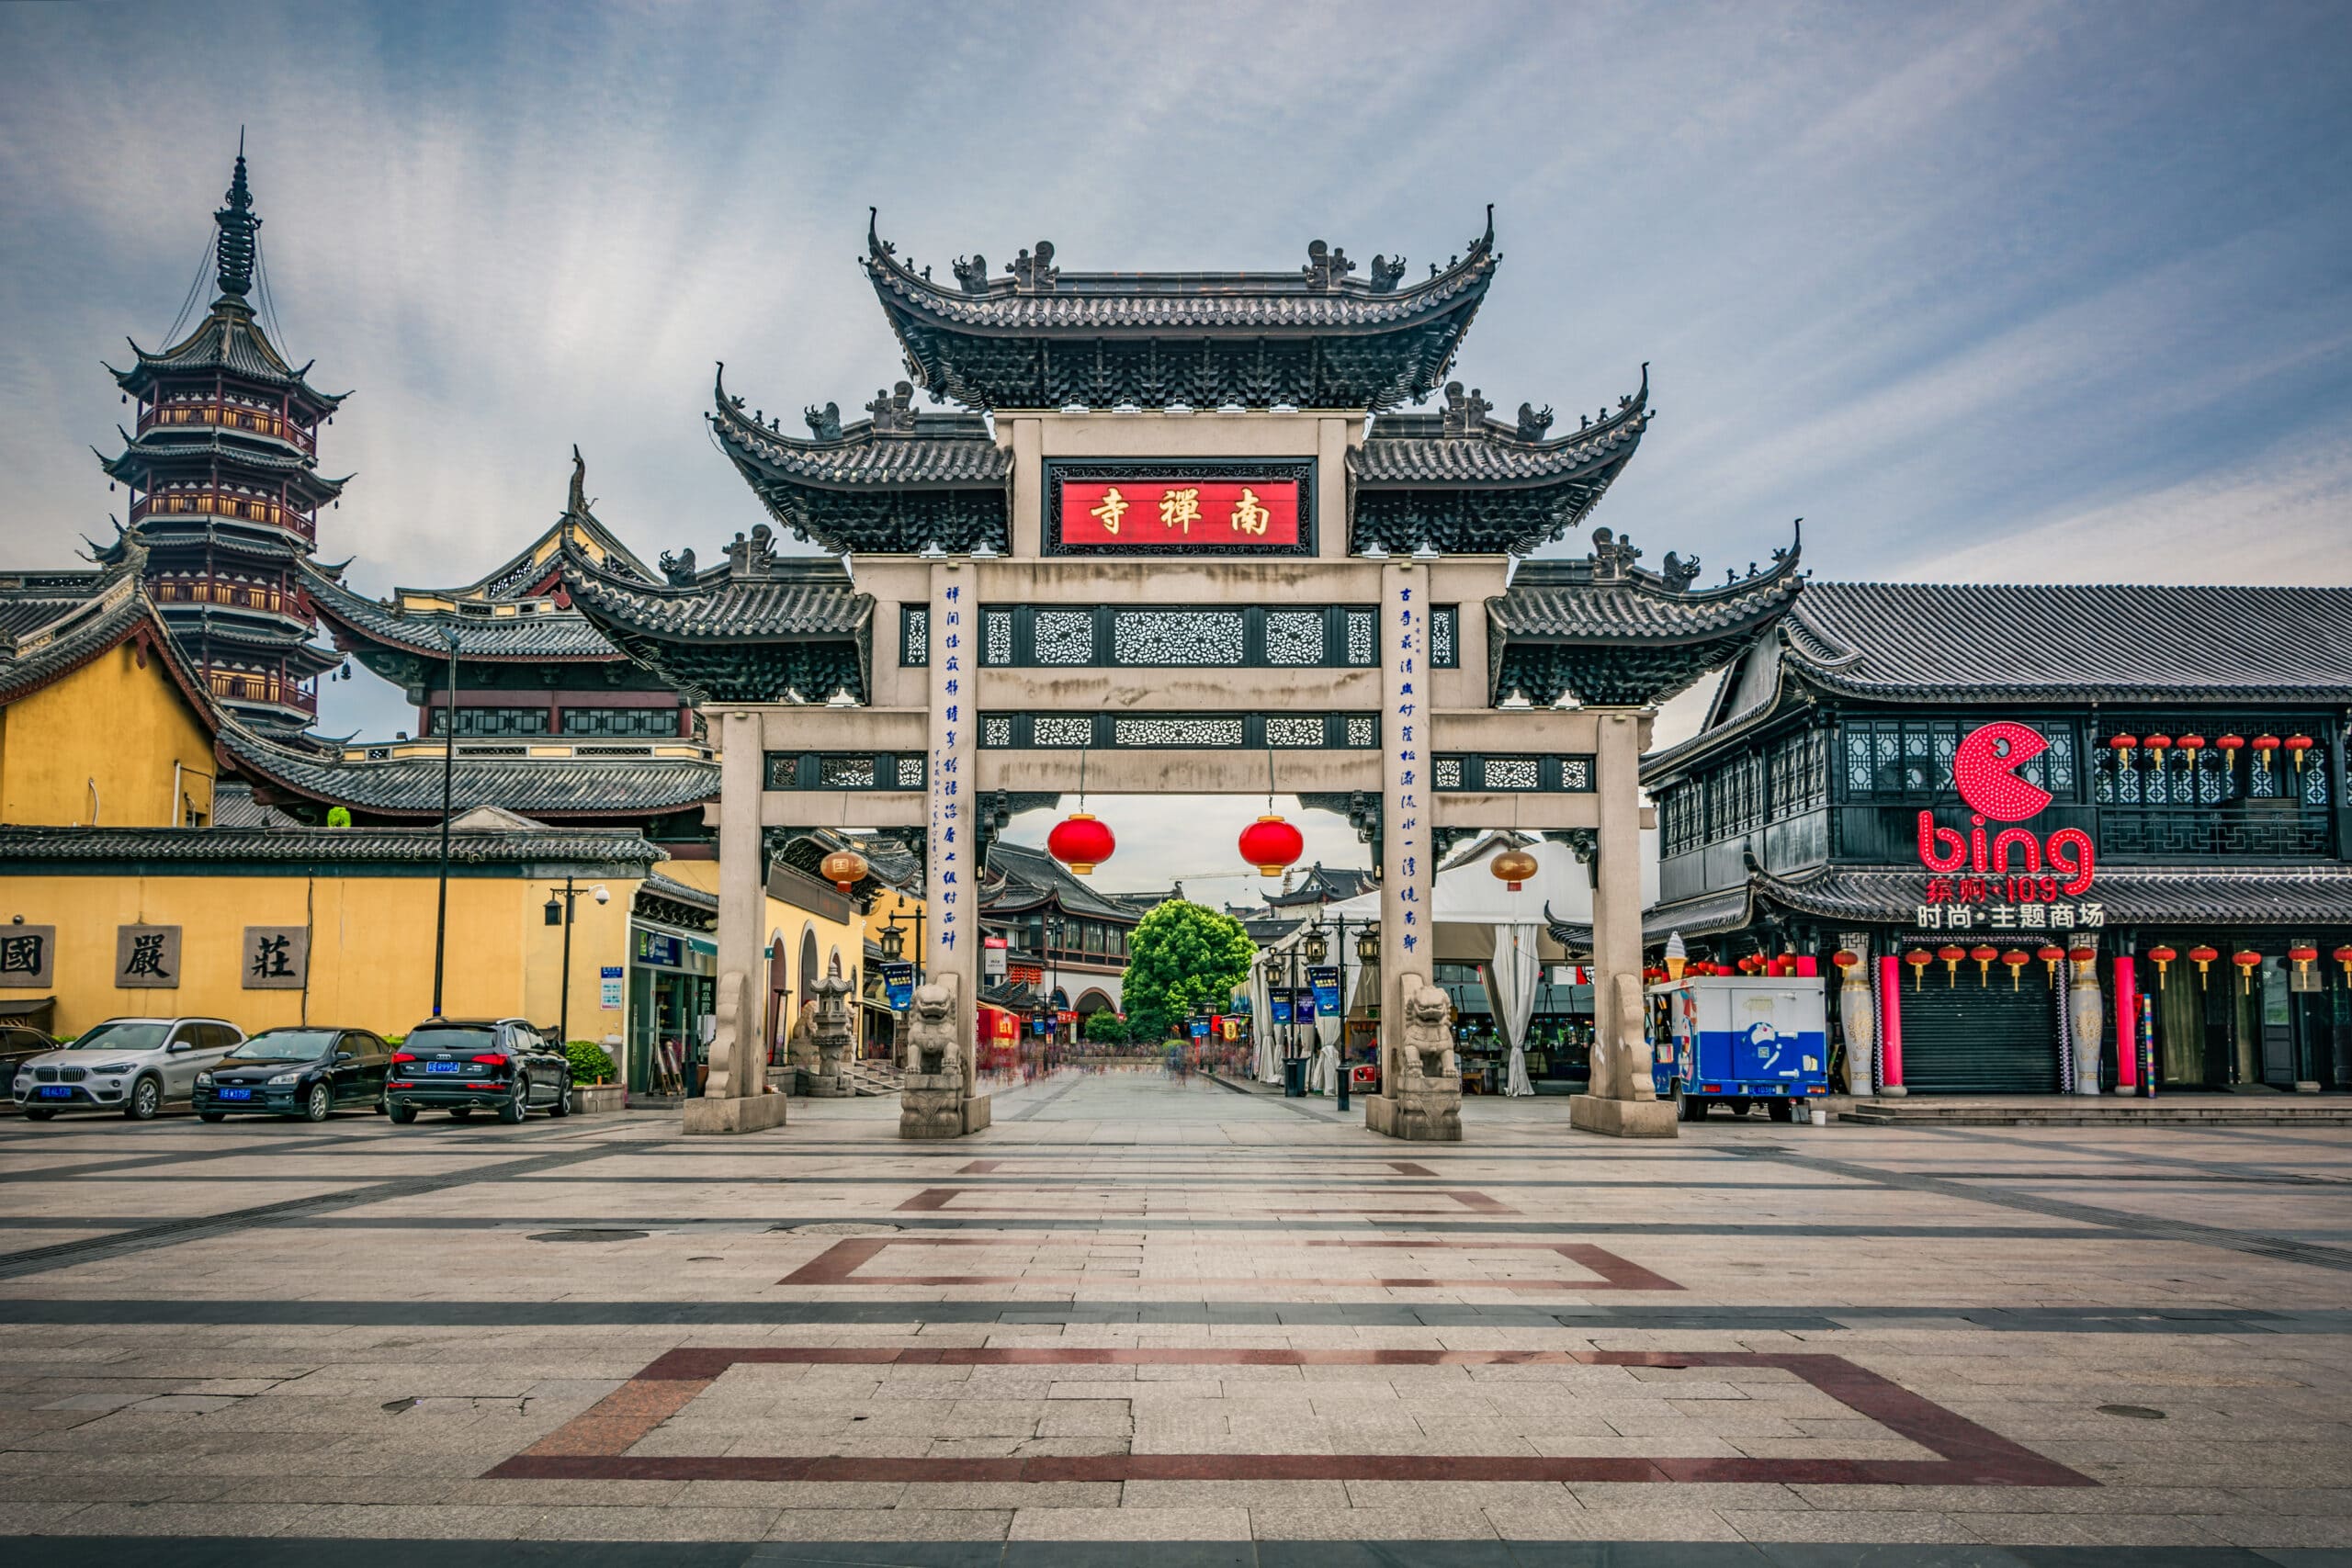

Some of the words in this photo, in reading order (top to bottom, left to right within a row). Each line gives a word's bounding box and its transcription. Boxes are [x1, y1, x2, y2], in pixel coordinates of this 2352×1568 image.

[1917, 809, 2095, 896] bing
[1917, 903, 2105, 929] 时尚·主题商场
[0, 934, 44, 976] 國
[124, 933, 172, 978] 嚴
[251, 934, 296, 979] 莊
